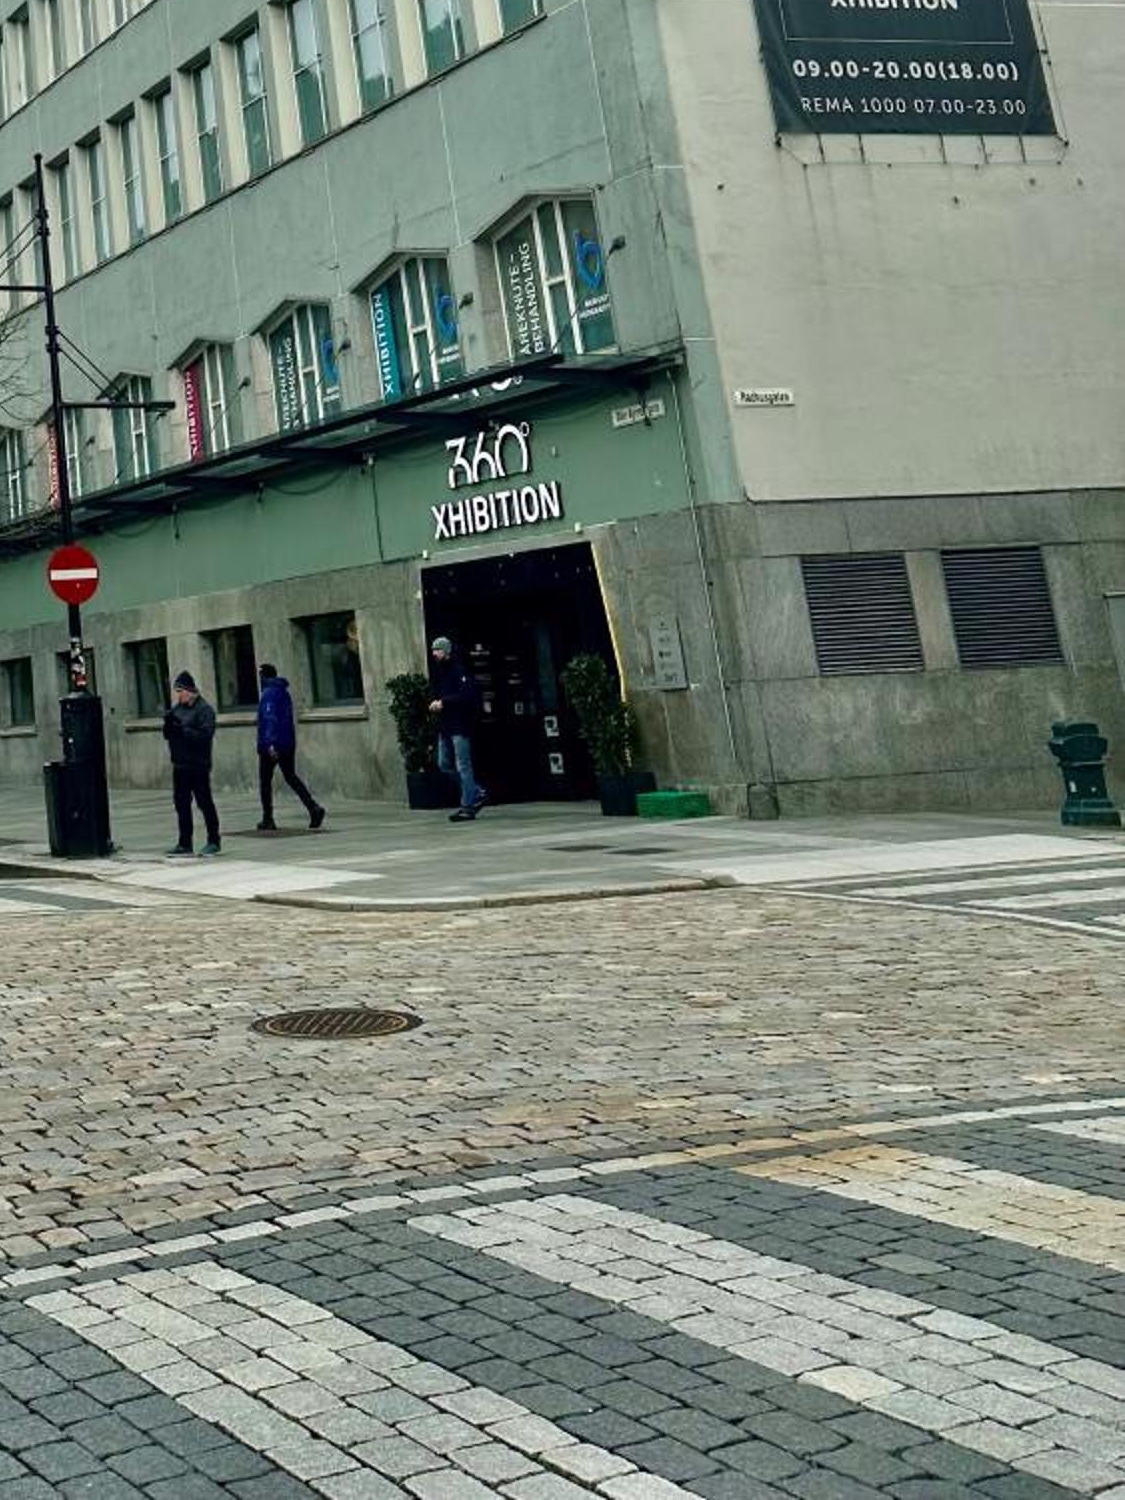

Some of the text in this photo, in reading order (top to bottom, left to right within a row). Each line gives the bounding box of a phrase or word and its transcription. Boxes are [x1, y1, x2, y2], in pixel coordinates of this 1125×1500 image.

[801, 97, 1026, 116] REMA 1000 07.00-23.00
[373, 293, 394, 394] XHIBITION
[431, 481, 561, 539] XHIBITION
